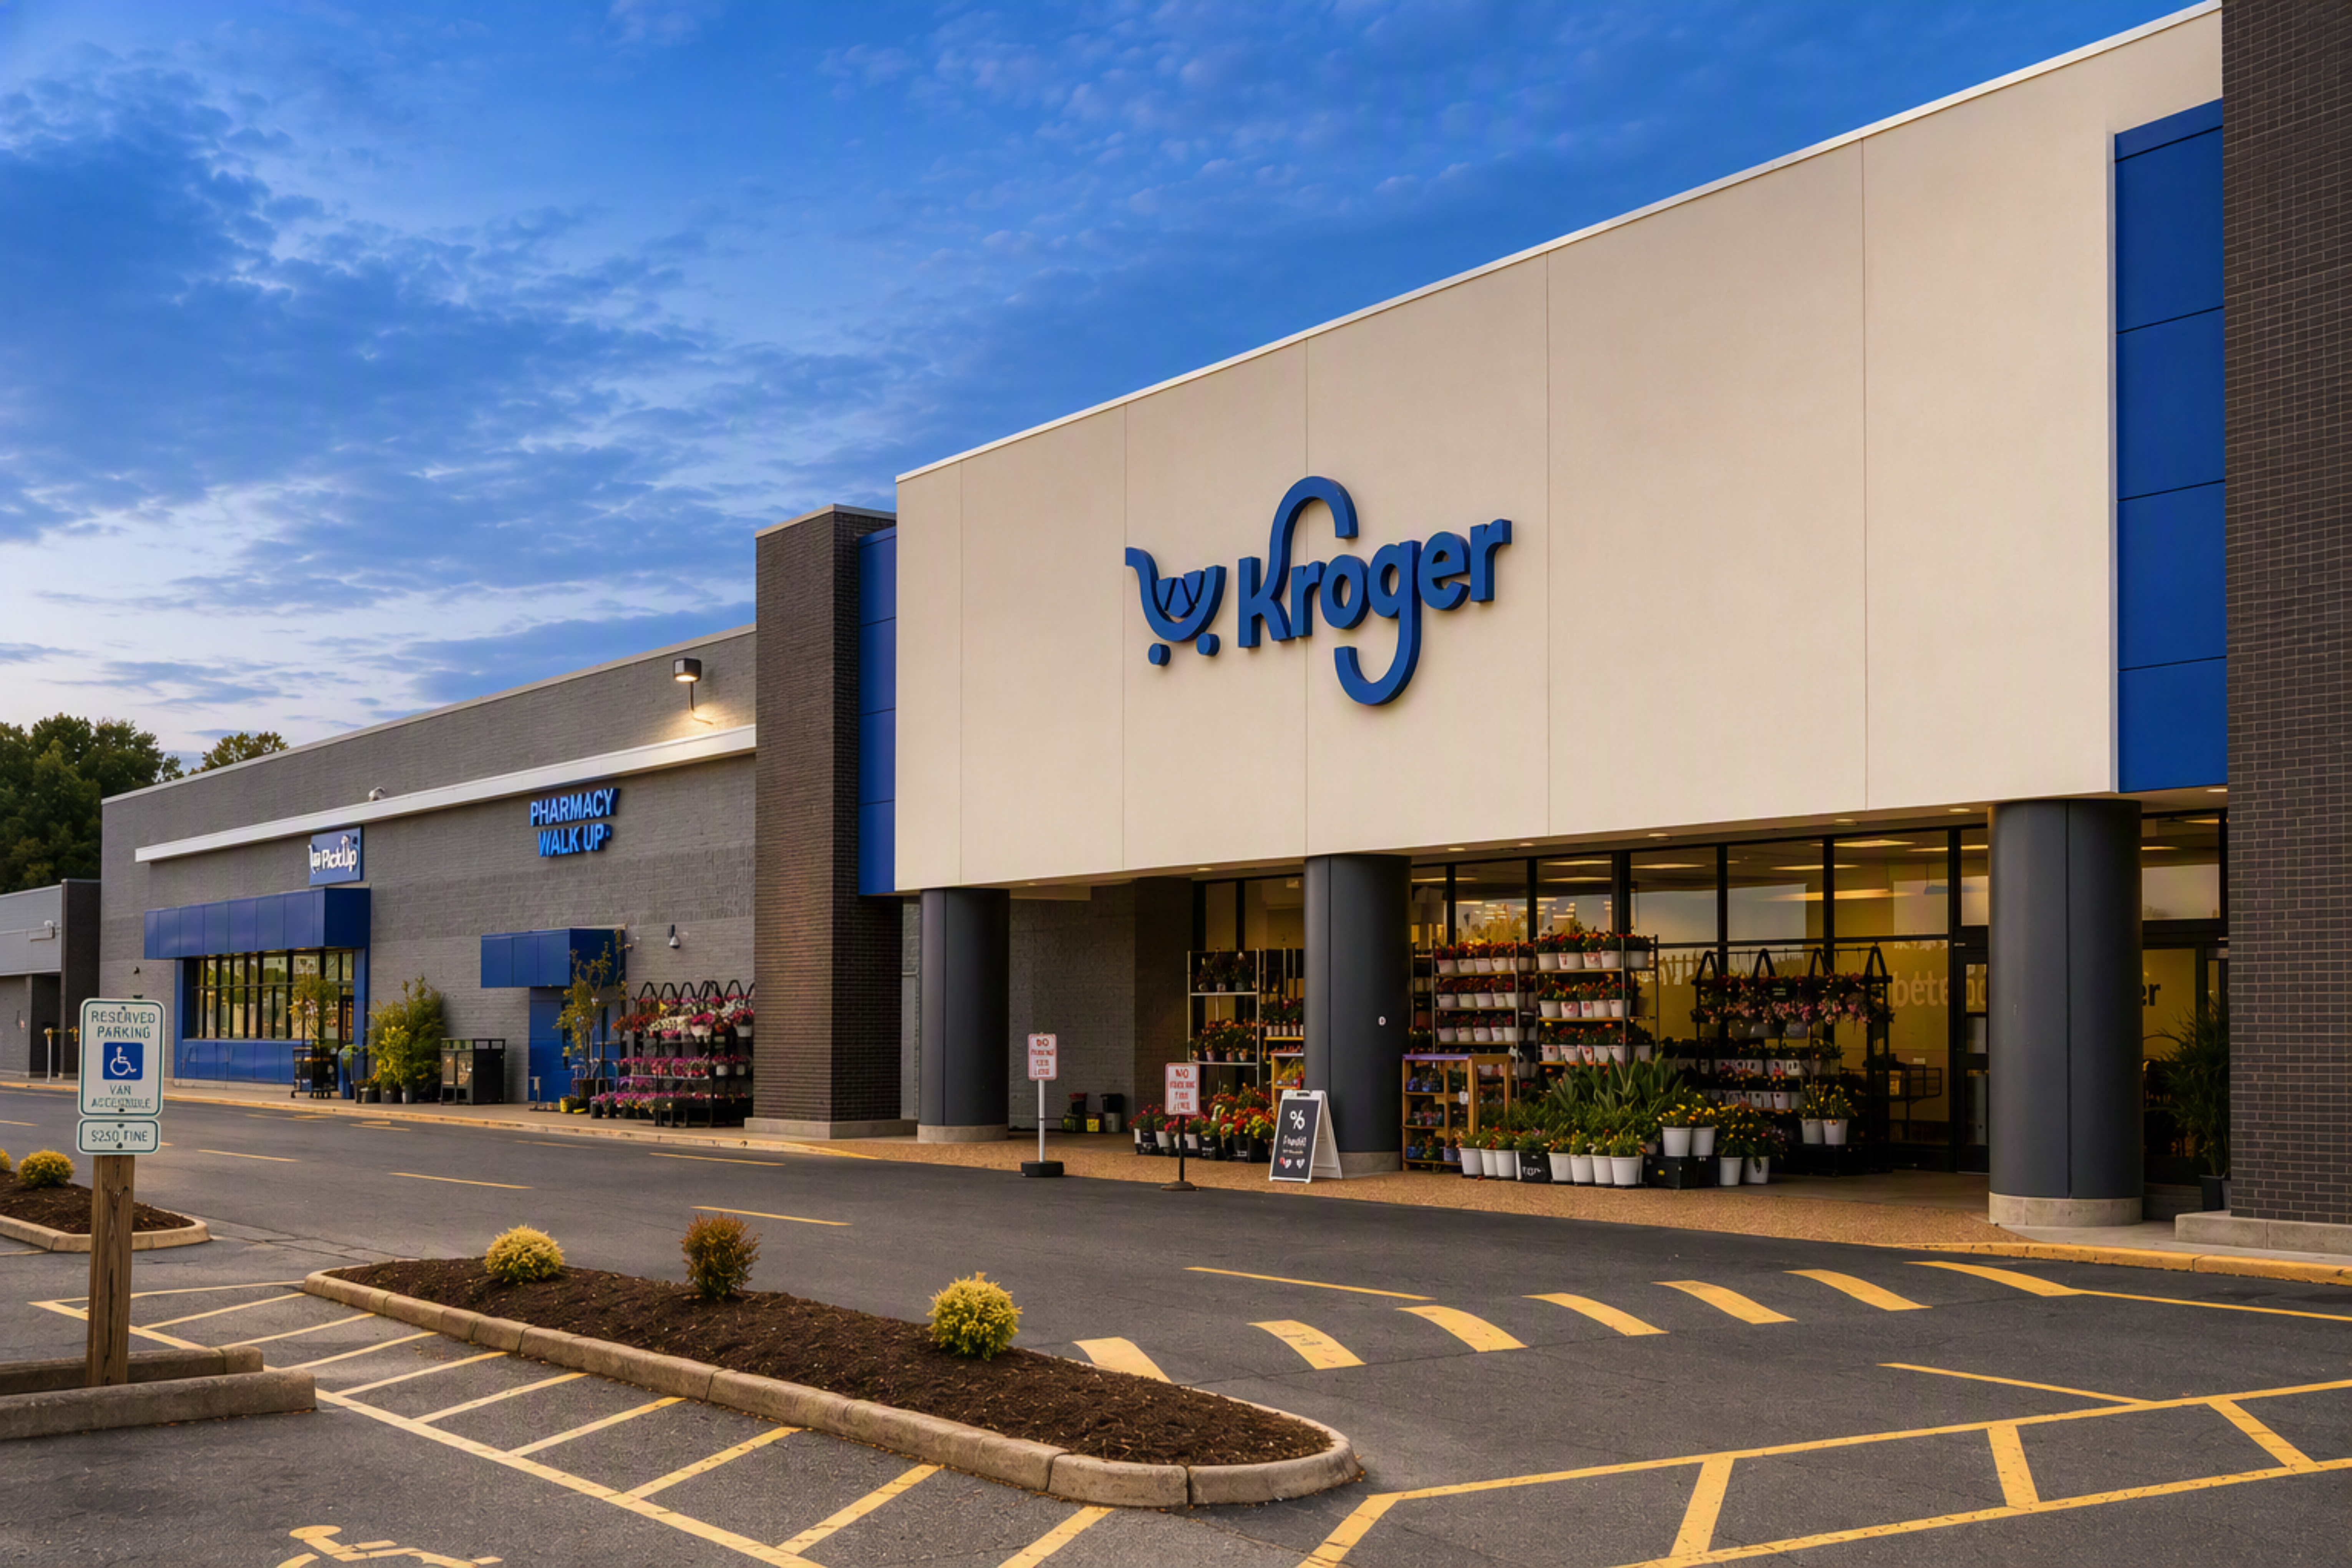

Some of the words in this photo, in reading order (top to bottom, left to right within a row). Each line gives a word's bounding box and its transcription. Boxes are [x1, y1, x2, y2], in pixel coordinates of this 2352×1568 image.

[1238, 476, 1512, 706] Kroger
[530, 787, 615, 827] PHARMACY
[539, 827, 580, 857] WALK
[583, 823, 605, 851] UP
[91, 1011, 155, 1024] RESERVED
[97, 1026, 151, 1038] PARKING
[109, 1085, 131, 1095] VAN
[124, 1130, 148, 1142] FINE
